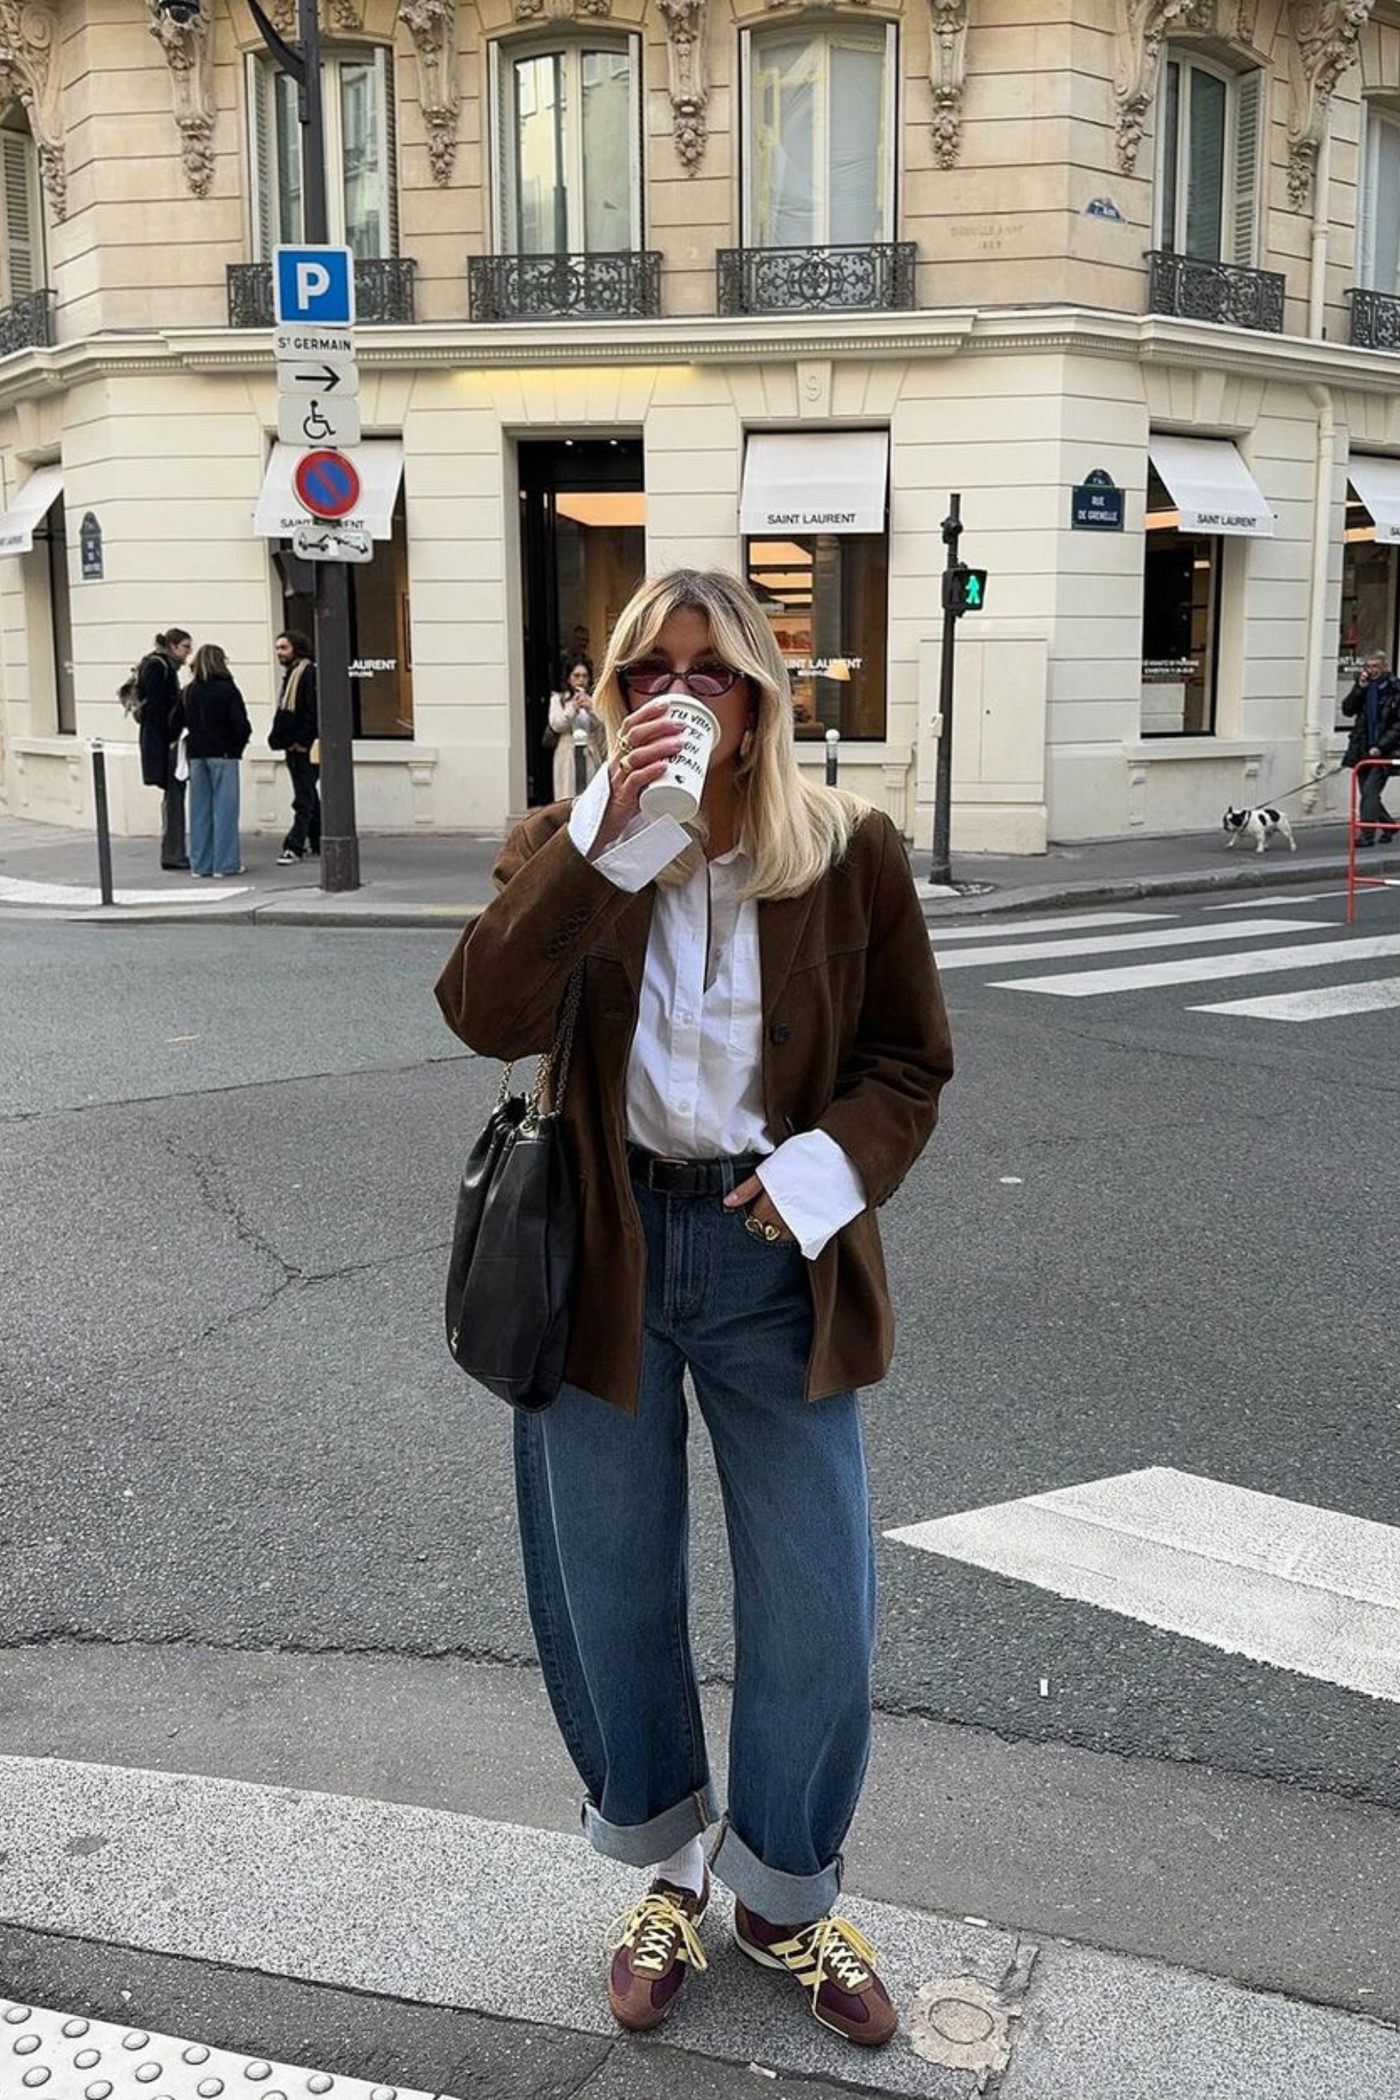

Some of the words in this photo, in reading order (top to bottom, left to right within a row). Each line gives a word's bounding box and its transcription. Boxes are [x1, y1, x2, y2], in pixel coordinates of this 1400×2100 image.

[296, 262, 330, 310] P
[294, 338, 351, 350] GERMAIN
[1091, 496, 1105, 506] RUE
[767, 514, 800, 524] SAINT
[803, 513, 856, 524] LAURENT
[1197, 513, 1220, 524] SAINT
[1221, 515, 1257, 527] LAURENT
[670, 709, 689, 719] TU
